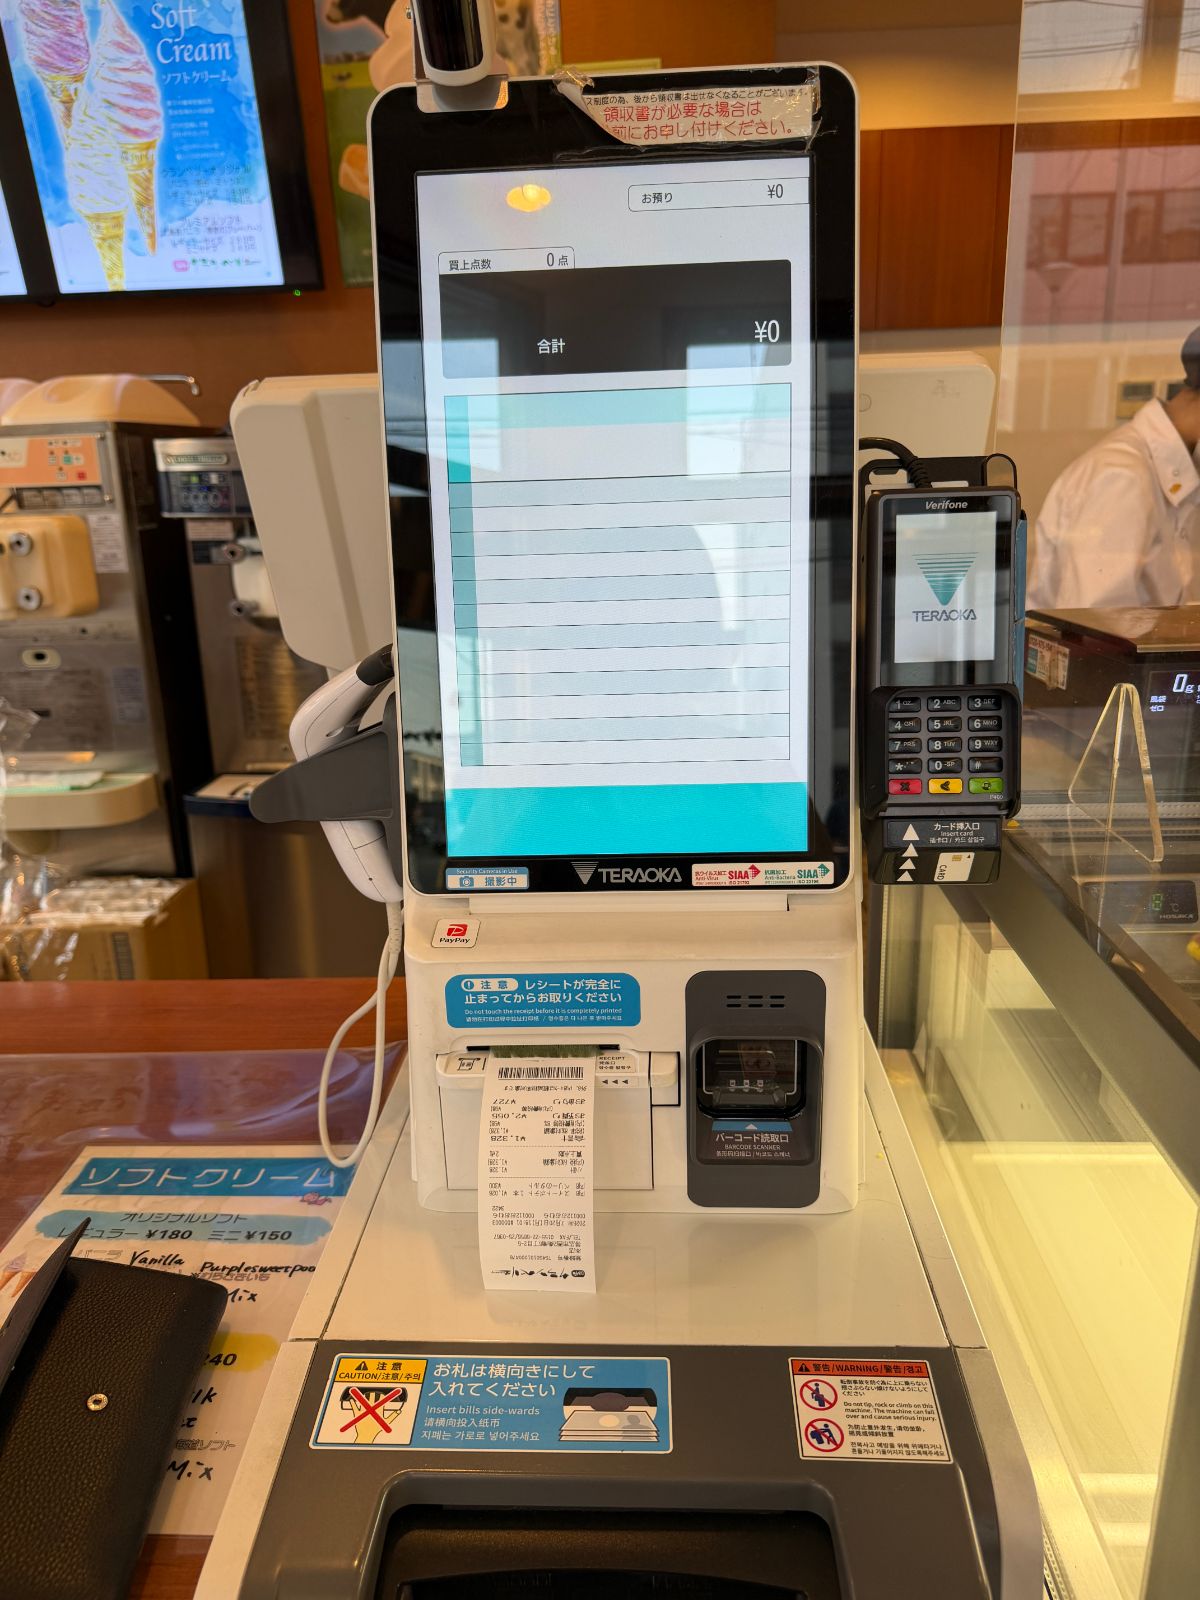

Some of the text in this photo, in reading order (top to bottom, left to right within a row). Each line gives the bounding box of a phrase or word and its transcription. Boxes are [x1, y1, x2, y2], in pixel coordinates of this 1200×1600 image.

[151, 0, 197, 41] Soft
[157, 38, 232, 64] Cream
[162, 70, 232, 85] ソフトクリーム
[603, 100, 762, 122] 領収書が必要な場合は
[641, 183, 784, 205] お預り ¥0
[448, 258, 491, 271] 買上点数
[537, 319, 780, 354] 合計 ¥0
[925, 501, 968, 510] Verifone
[912, 608, 977, 622] TERAOKA
[934, 698, 941, 709] 2
[974, 698, 982, 708] 3
[894, 721, 902, 730] 4
[934, 720, 941, 729] 5
[974, 719, 981, 729] 6
[894, 741, 901, 751] 7
[934, 741, 942, 750] 8
[974, 740, 982, 749] 9
[934, 760, 943, 770] 0
[933, 822, 981, 831] カード挿入口
[598, 867, 683, 883] TERAOKA
[728, 870, 749, 880] SIAA
[796, 869, 818, 879] SIAA
[937, 864, 948, 881] CARD
[485, 876, 517, 887] 撮影中
[439, 936, 471, 945] PayPay
[525, 979, 621, 990] レシートが完全に
[464, 992, 622, 1004] 止まってからお取りください
[715, 1133, 789, 1143] バーコード読取口
[80, 1167, 336, 1188] ソフトクリーム
[120, 1212, 249, 1224] オリジナルソフト
[145, 1229, 193, 1241] ¥180
[208, 1230, 239, 1241] ミニ
[244, 1230, 292, 1241] ¥150
[129, 1249, 186, 1267] Vanilla
[433, 1362, 596, 1379] お札は横向きにして
[428, 1381, 557, 1397] 入れてください
[426, 1405, 540, 1415] Insert bills side-wards
[424, 1417, 501, 1428] 请横向投入纸币
[455, 1430, 485, 1441] 가로로
[489, 1431, 541, 1442] 넣어주세요
[167, 1459, 214, 1481] Mix
